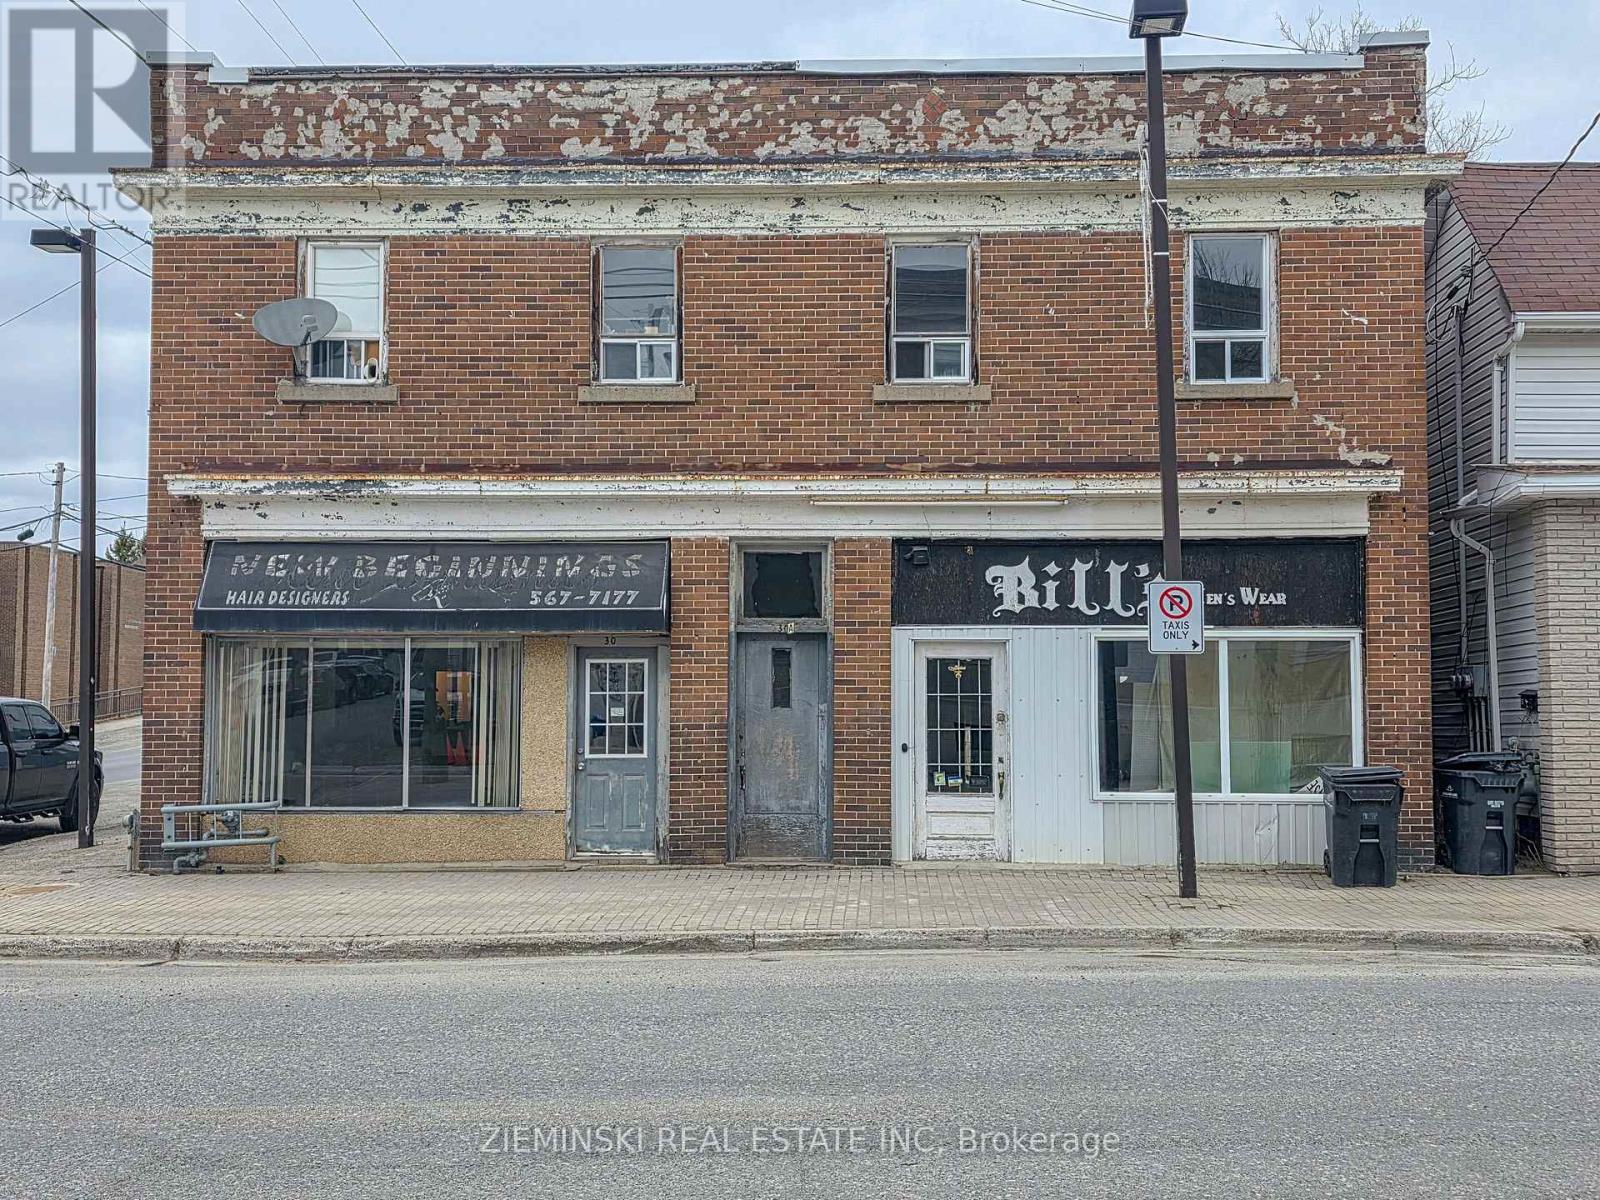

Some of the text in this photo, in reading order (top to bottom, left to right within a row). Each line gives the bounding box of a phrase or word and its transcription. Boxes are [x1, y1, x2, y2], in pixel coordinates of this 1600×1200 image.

[352, 554, 643, 578] BEGINNINGS
[985, 555, 1165, 618] Bill'
[226, 590, 350, 605] HAIR DESIGNERS
[529, 590, 640, 605] 567-7177
[1205, 591, 1236, 606] EN'S
[1162, 621, 1190, 630] TAXIS
[604, 636, 616, 645] 30
[1163, 630, 1189, 640] ONLY
